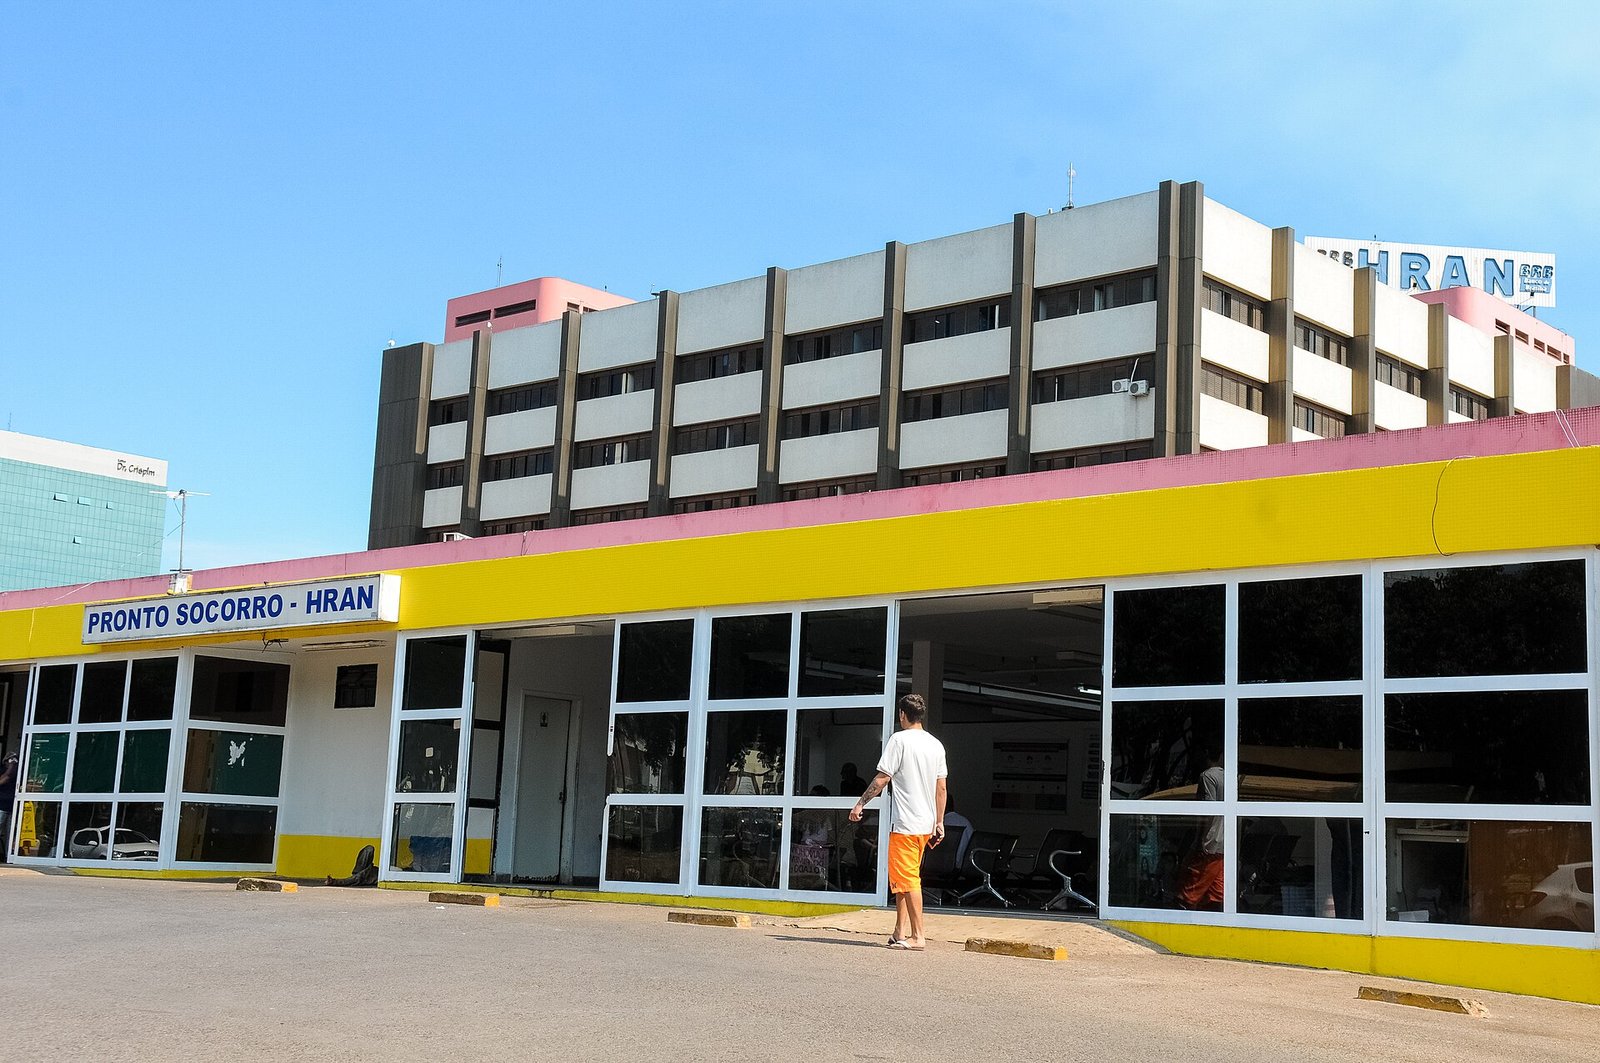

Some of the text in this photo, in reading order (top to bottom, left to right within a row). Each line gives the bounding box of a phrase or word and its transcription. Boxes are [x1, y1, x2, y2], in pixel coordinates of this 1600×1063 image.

[1317, 249, 1353, 269] RB
[1358, 248, 1514, 297] HRAN
[1519, 264, 1553, 279] BRB
[88, 605, 169, 634] PRONTO
[176, 594, 283, 626] SOCORRO
[306, 585, 374, 614] HRAN
